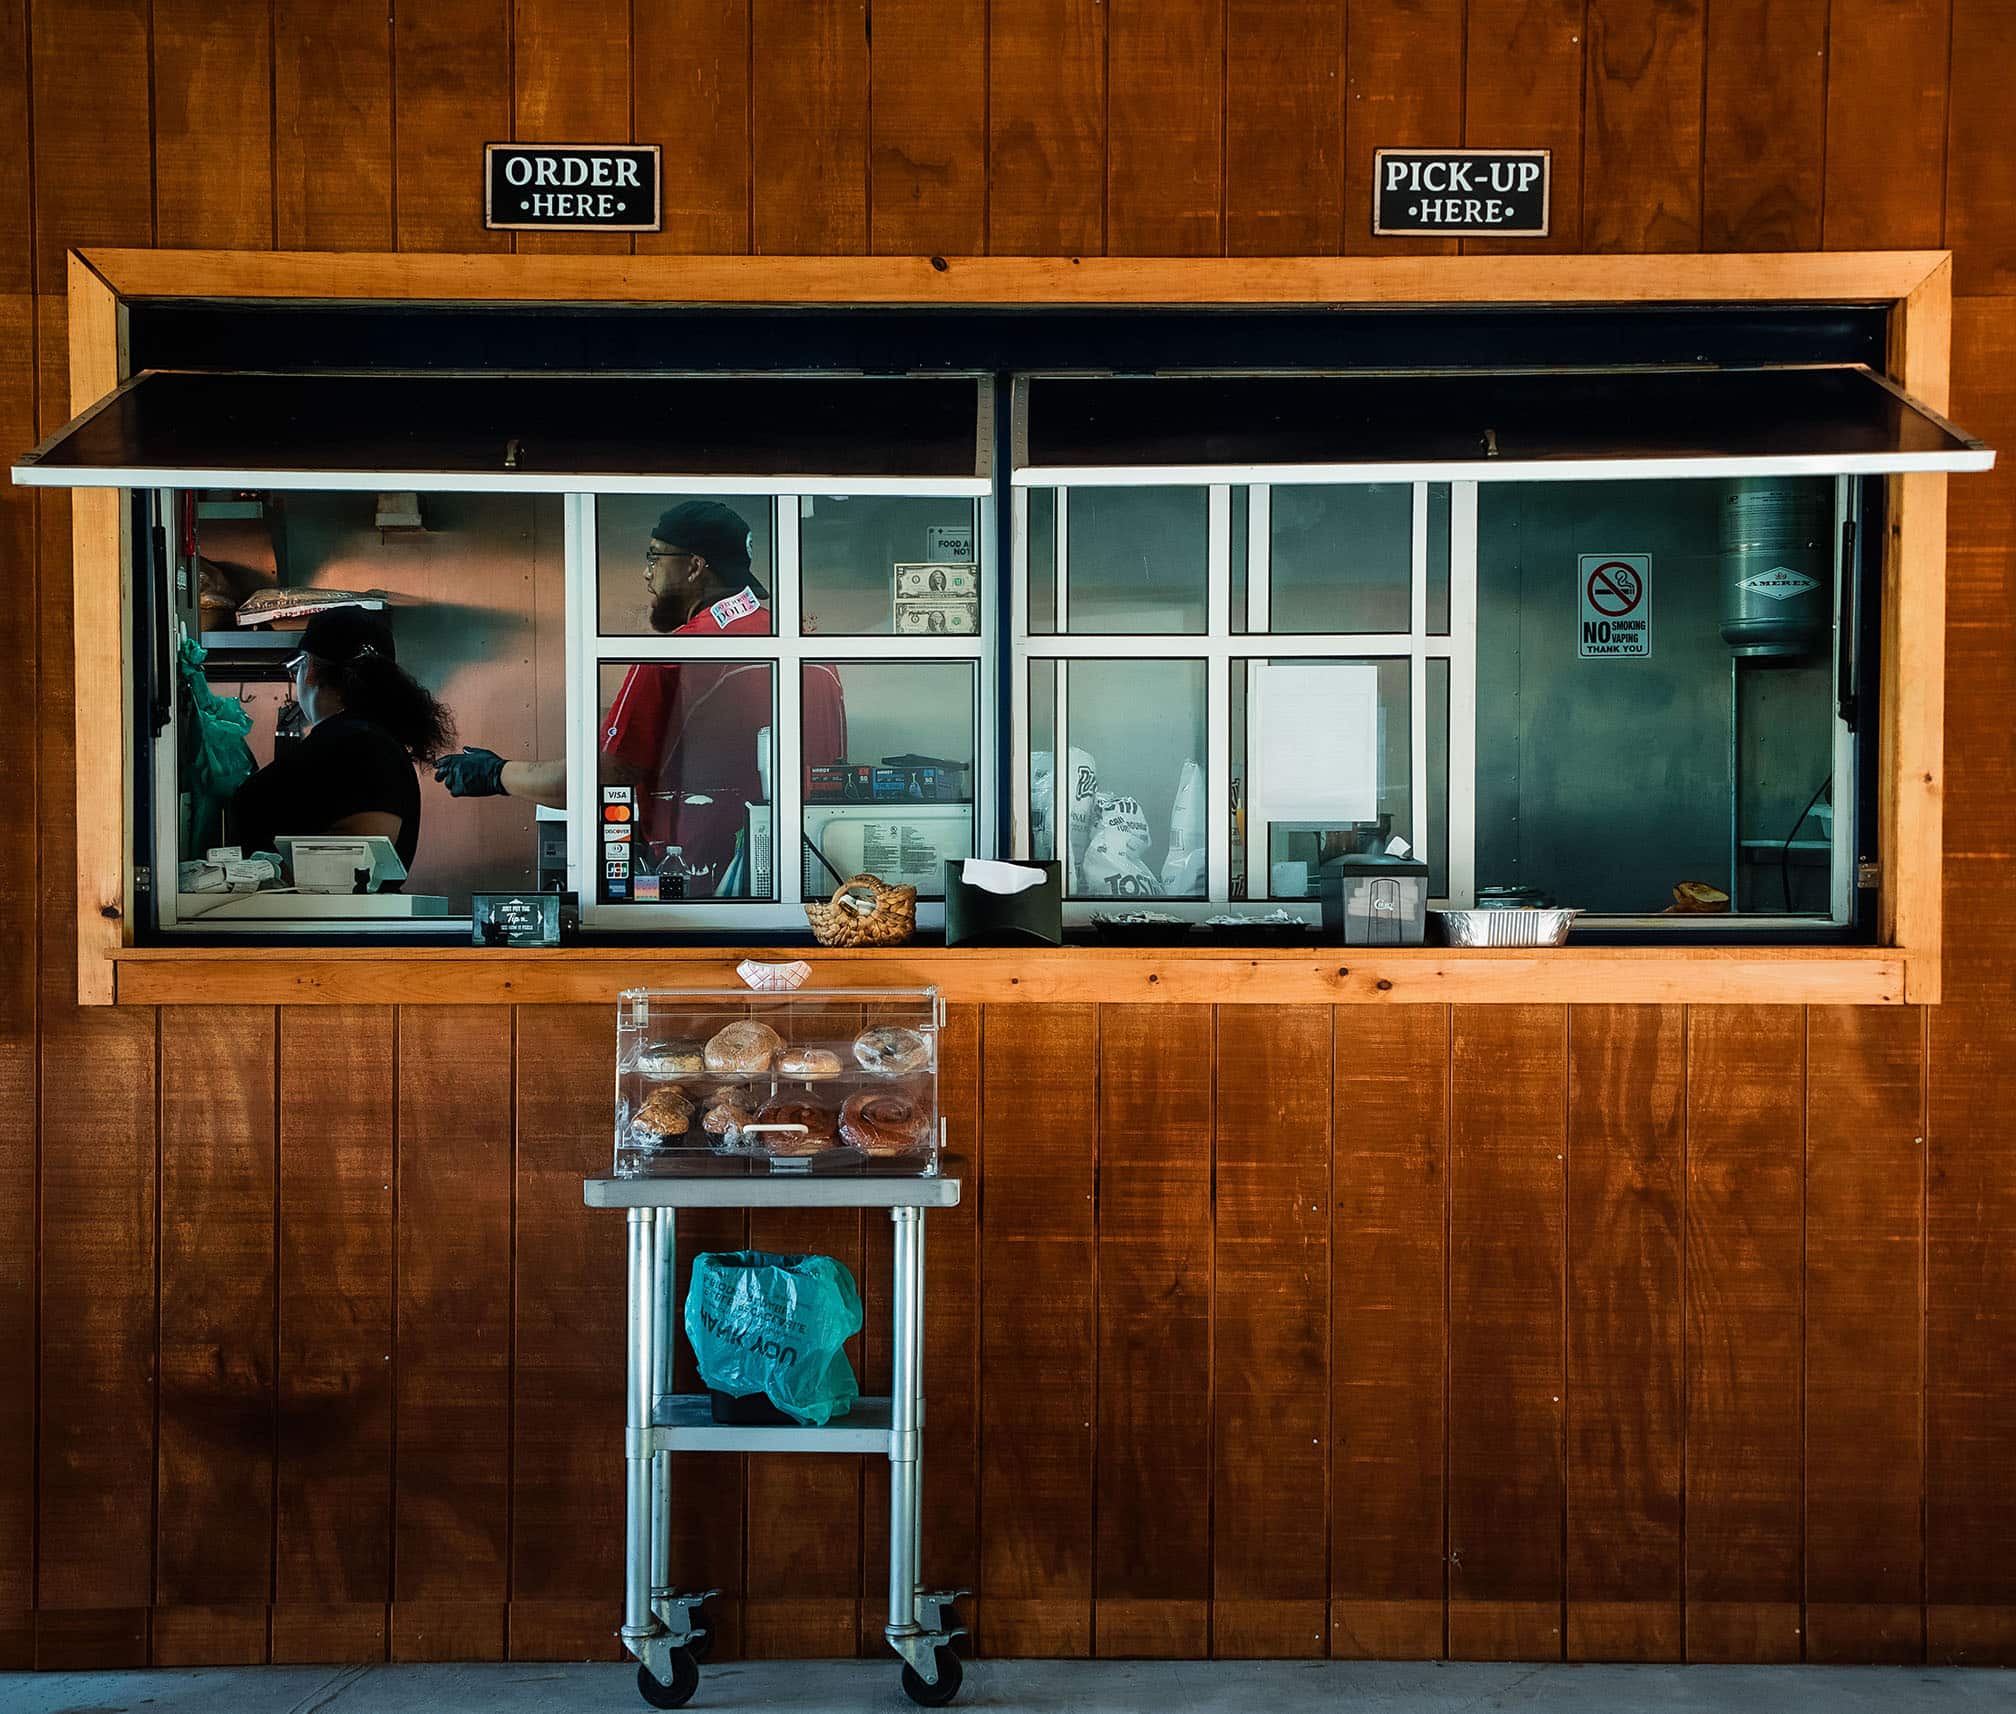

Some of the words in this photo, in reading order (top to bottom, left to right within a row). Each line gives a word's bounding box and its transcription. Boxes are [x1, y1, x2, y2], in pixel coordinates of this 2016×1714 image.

[505, 157, 640, 187] ORDER
[1386, 161, 1540, 192] PICK-UP
[532, 193, 615, 217] HERE
[1420, 199, 1503, 223] HERE
[938, 540, 961, 548] FOOD
[1611, 620, 1646, 631] SMOKING
[1583, 621, 1611, 643] NO
[1611, 633, 1639, 643] VAPING
[1587, 645, 1620, 653] THANK
[608, 791, 627, 799] VISA
[506, 912, 520, 924] Tip
